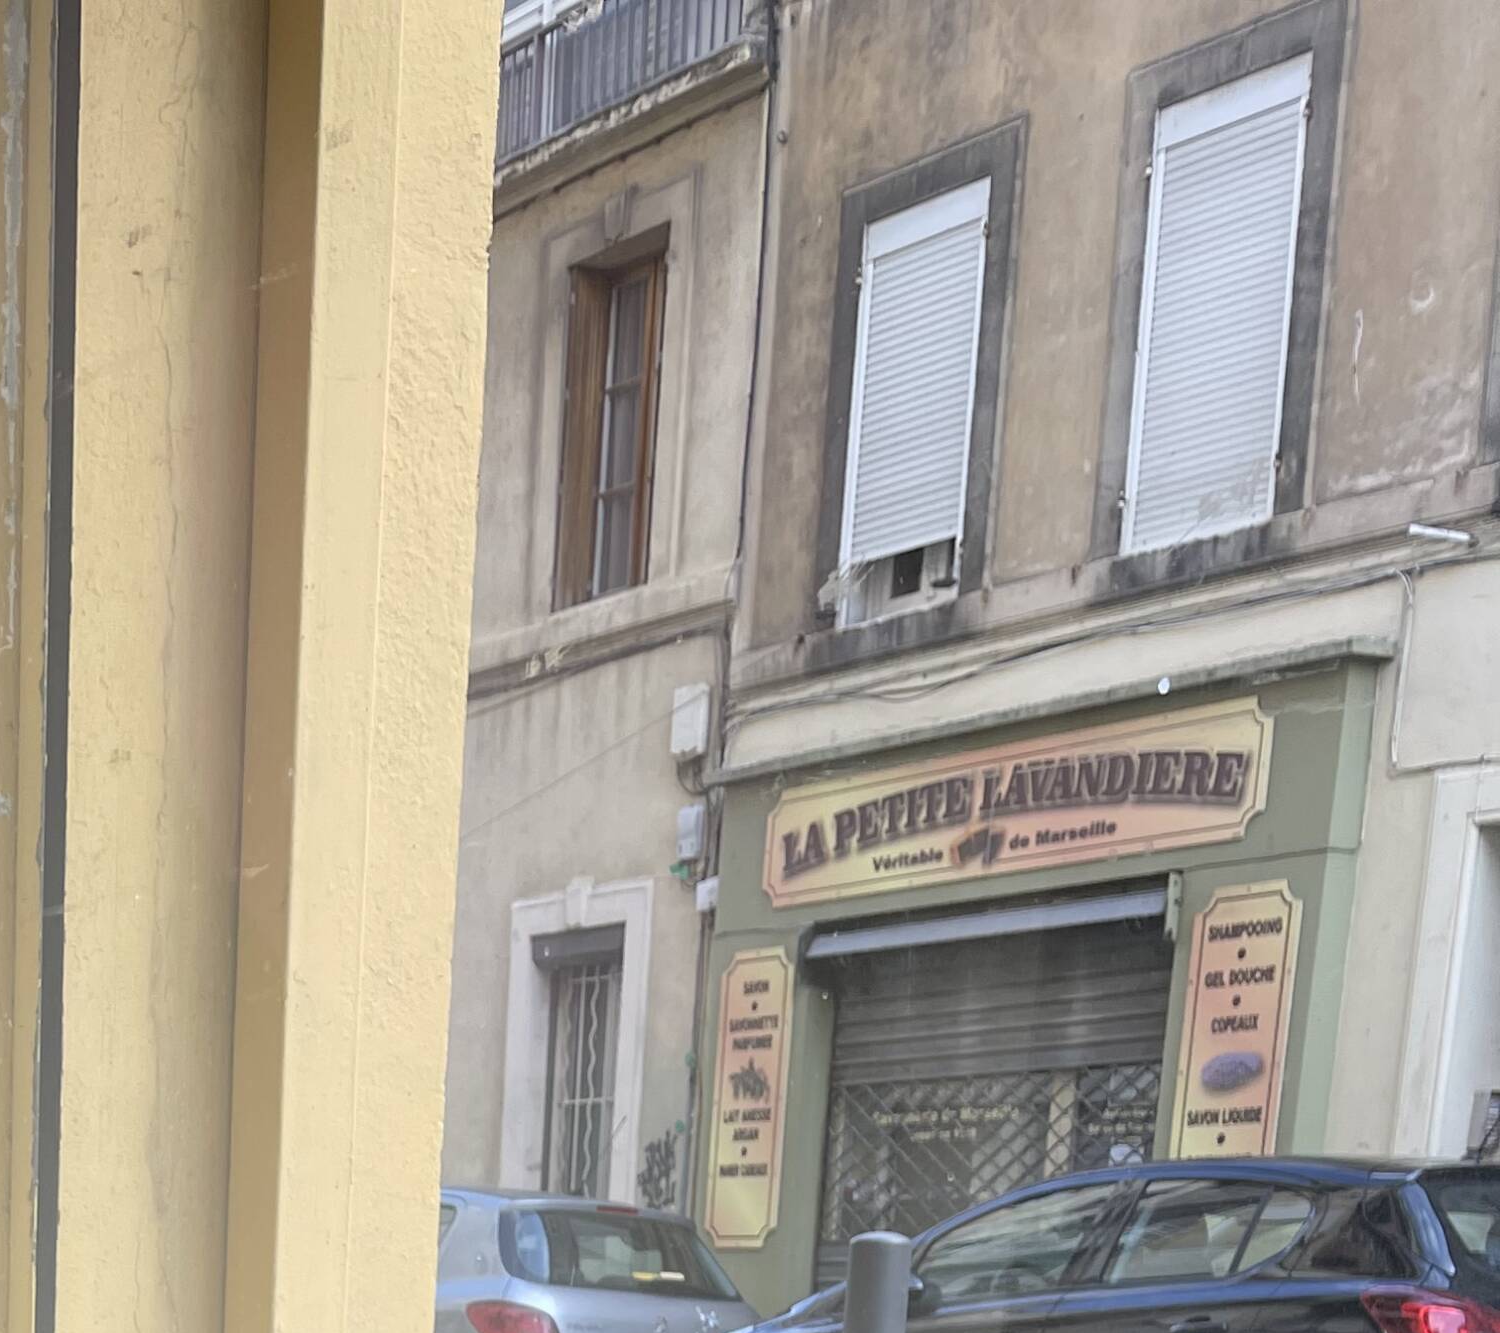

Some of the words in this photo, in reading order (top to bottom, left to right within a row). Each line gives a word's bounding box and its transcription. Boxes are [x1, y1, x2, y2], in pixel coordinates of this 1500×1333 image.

[782, 820, 828, 872] LA
[833, 777, 970, 853] PETITE
[980, 750, 1248, 812] LAVANDIERE
[873, 847, 944, 872] Véritable
[1009, 833, 1030, 850] de
[1035, 819, 1117, 846] Marseille
[1208, 917, 1282, 942] SHAMPOOING
[1204, 970, 1225, 988] GEL
[1228, 964, 1276, 986] DOUCHE
[1210, 1013, 1259, 1034] COPEAUX
[1187, 1108, 1219, 1126] SAVON
[1221, 1105, 1262, 1124] LIQUIDE
